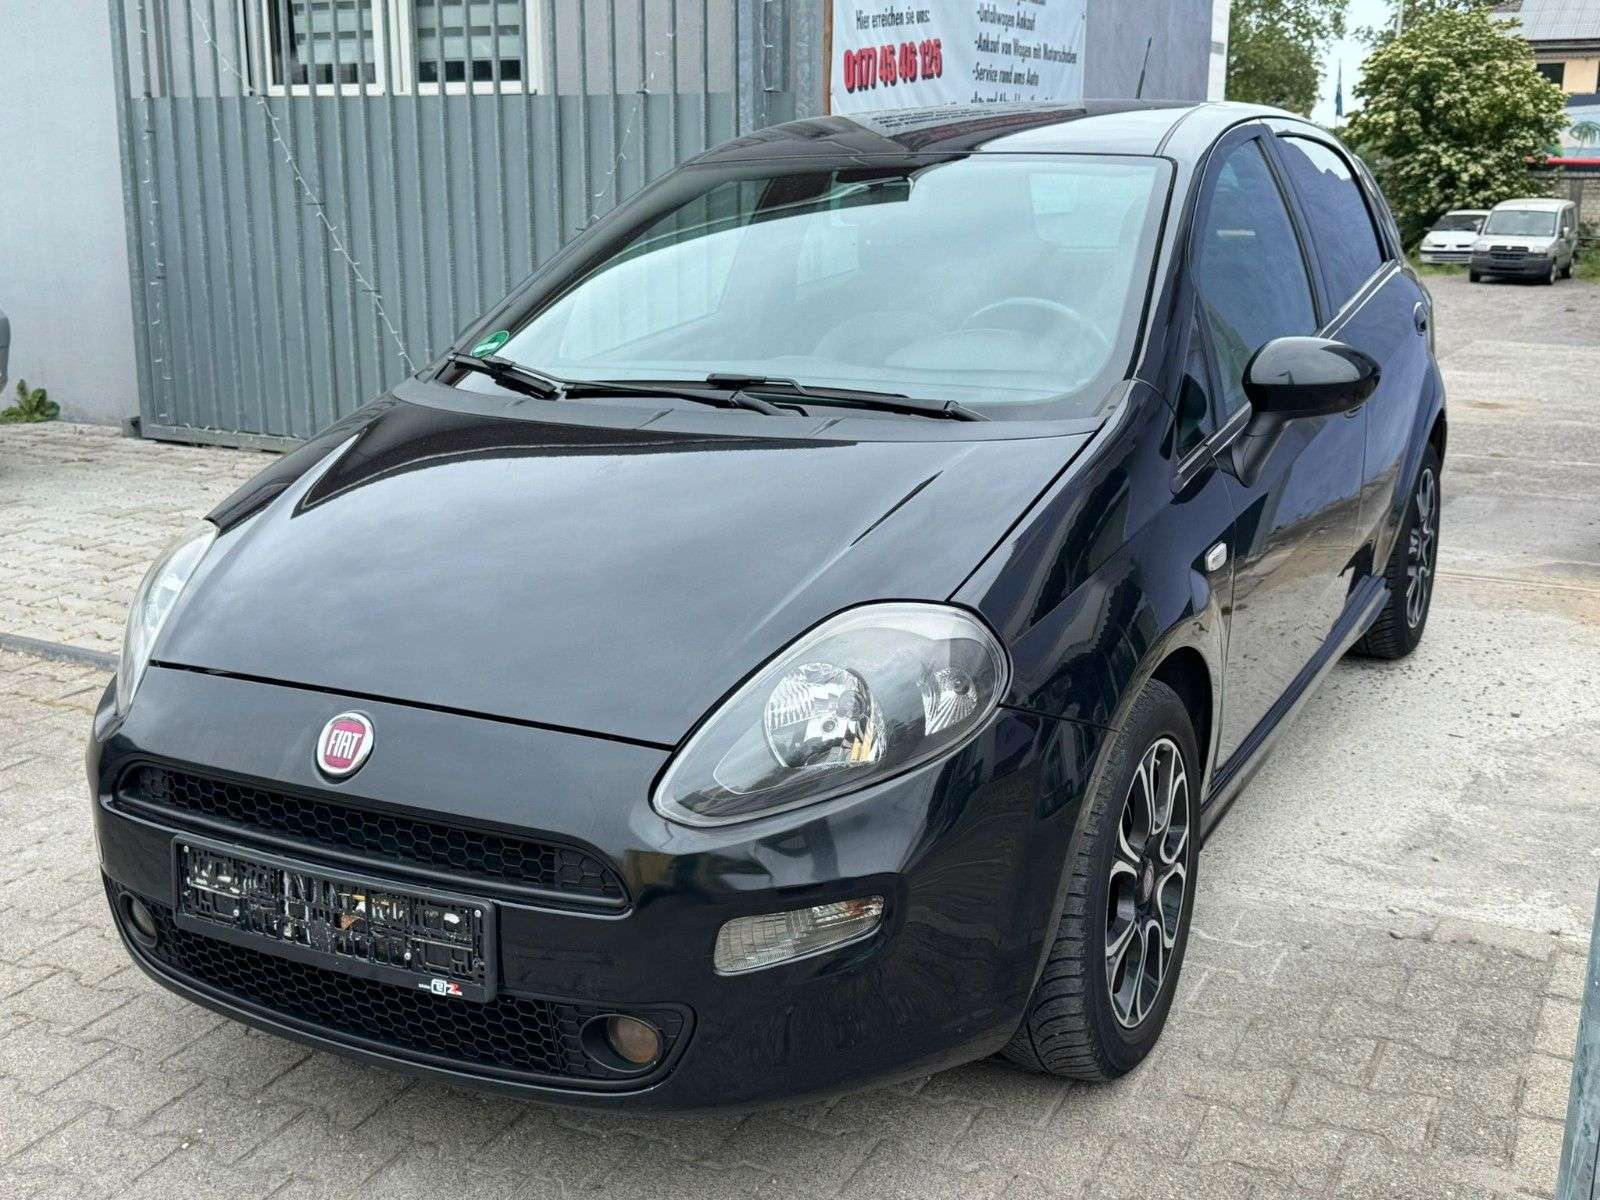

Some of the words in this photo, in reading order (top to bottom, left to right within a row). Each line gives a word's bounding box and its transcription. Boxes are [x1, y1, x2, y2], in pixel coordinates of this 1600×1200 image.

[856, 10, 869, 30] Hier
[871, 6, 905, 28] erreichen
[905, 5, 915, 25] sie
[1001, 42, 1012, 55] von
[1012, 38, 1032, 63] Wagen
[1033, 42, 1042, 59] mit
[1042, 43, 1078, 64] Motorschaden
[844, 47, 877, 94] 0177
[879, 44, 897, 87] 45
[999, 64, 1014, 84] rund
[1014, 72, 1025, 85] ums
[1026, 68, 1040, 87] Auto
[326, 729, 363, 759] FIAT
